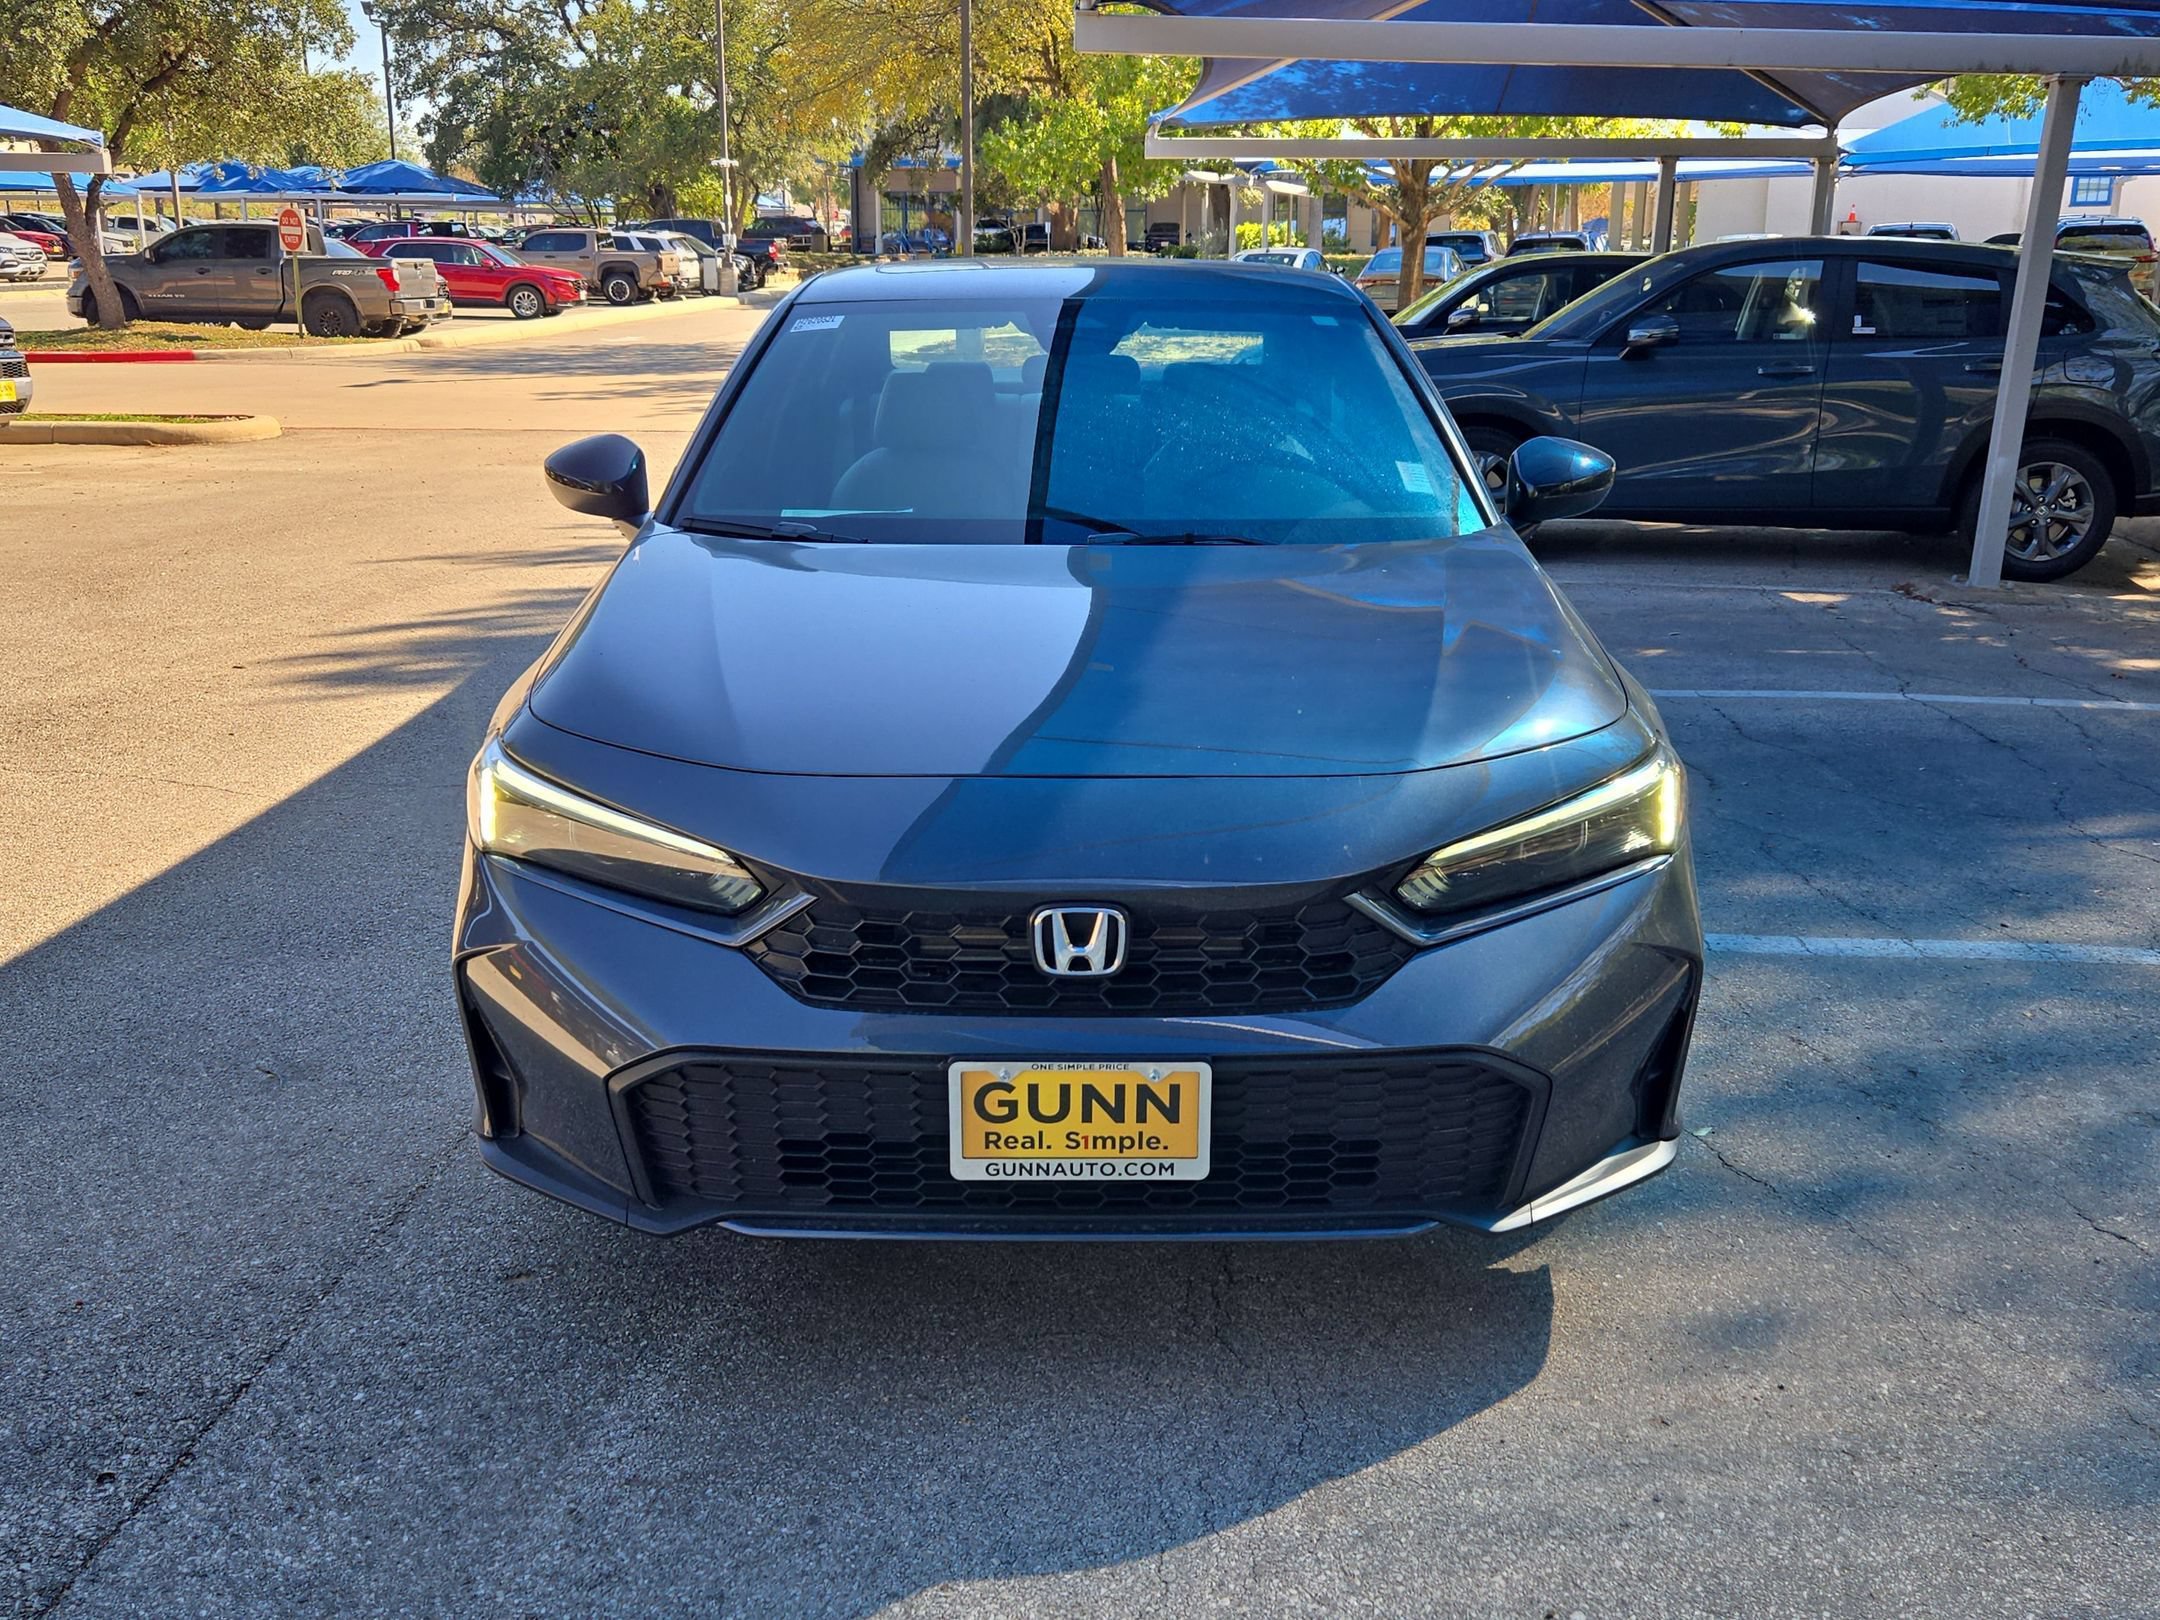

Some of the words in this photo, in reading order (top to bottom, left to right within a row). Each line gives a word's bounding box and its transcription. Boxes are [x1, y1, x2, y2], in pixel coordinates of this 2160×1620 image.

[282, 216, 289, 225] DO
[289, 217, 299, 225] NOT
[284, 234, 299, 244] ENTER
[973, 1081, 1181, 1124] GUNN
[984, 1131, 1052, 1150] Real.
[985, 1162, 1175, 1177] GUNNAUTO.COM
